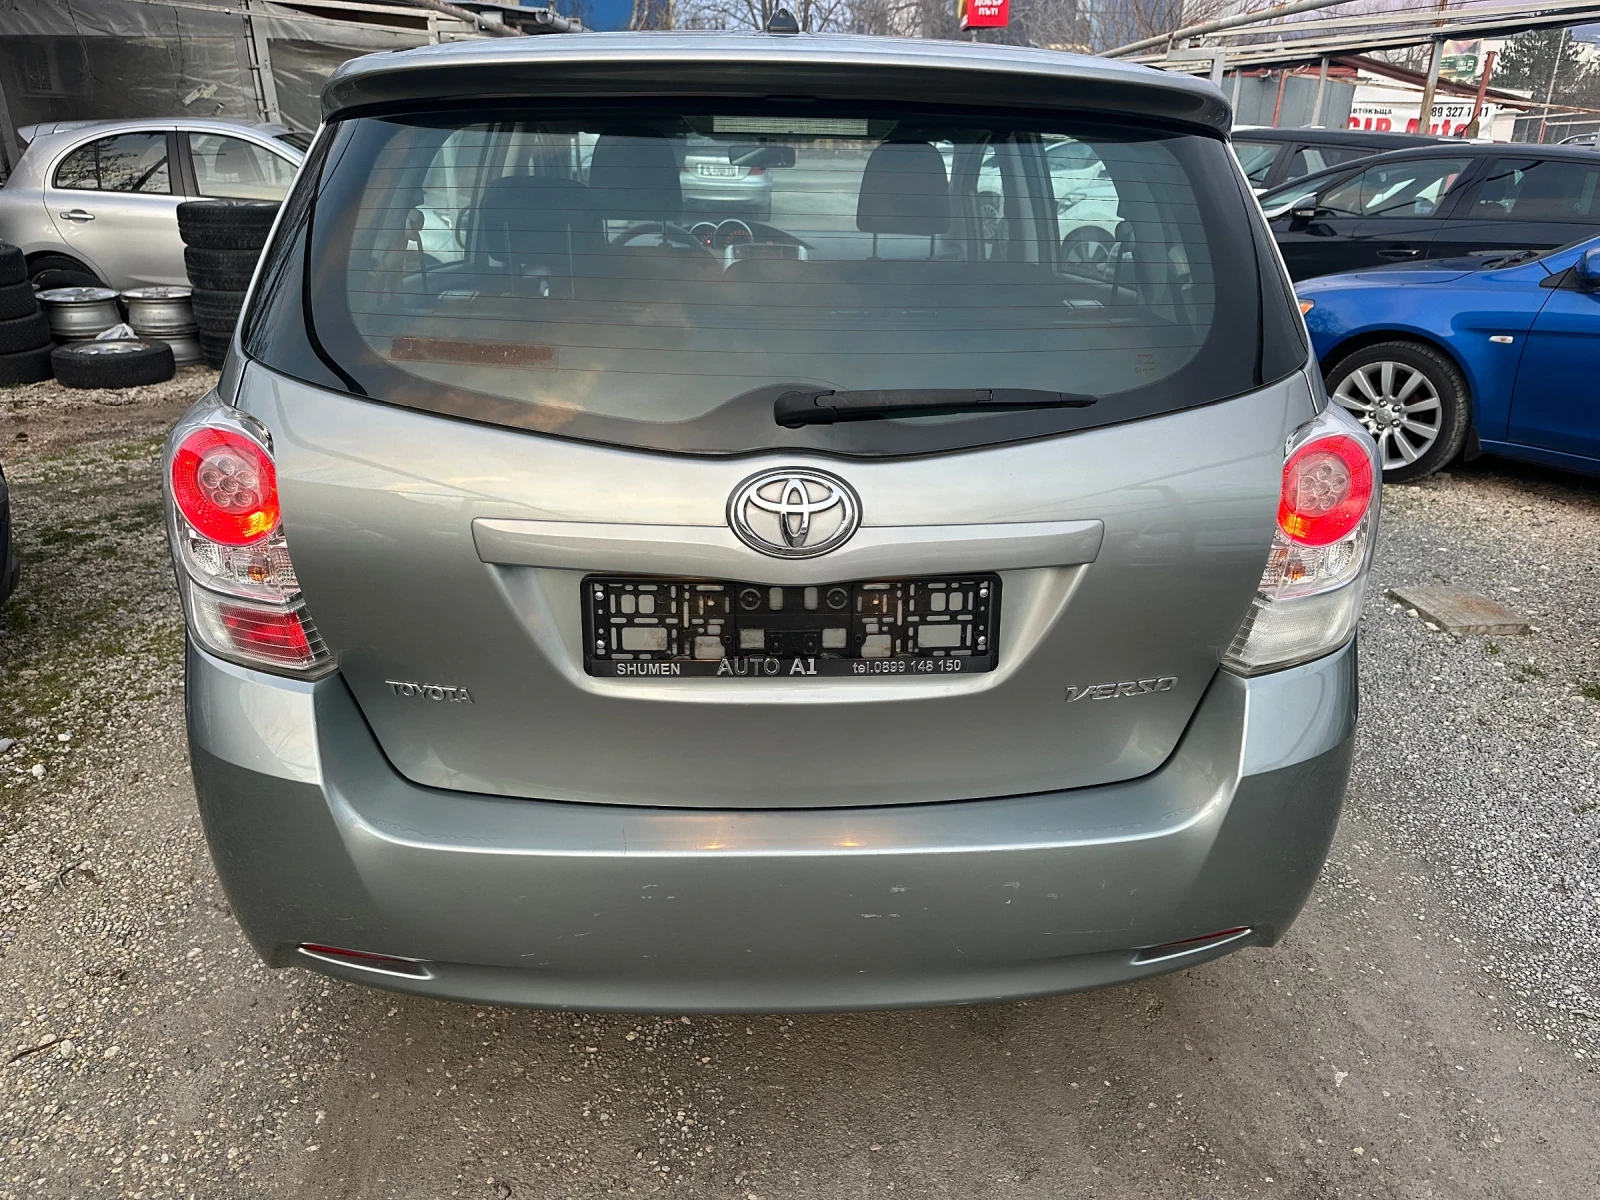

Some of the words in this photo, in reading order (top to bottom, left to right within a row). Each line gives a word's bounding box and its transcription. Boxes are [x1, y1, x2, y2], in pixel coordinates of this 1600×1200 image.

[1350, 107, 1393, 115] ВТОКЪЩА
[1446, 106, 1464, 118] 327
[1466, 106, 1490, 118] 111
[616, 662, 681, 675] SHUMEN
[716, 656, 781, 676] AUTO
[789, 657, 818, 675] A1
[852, 660, 906, 674] tel.0899
[910, 660, 934, 672] 148
[938, 659, 962, 672] 150
[385, 680, 475, 704] TOYOTA
[1065, 675, 1178, 702] VERSO
